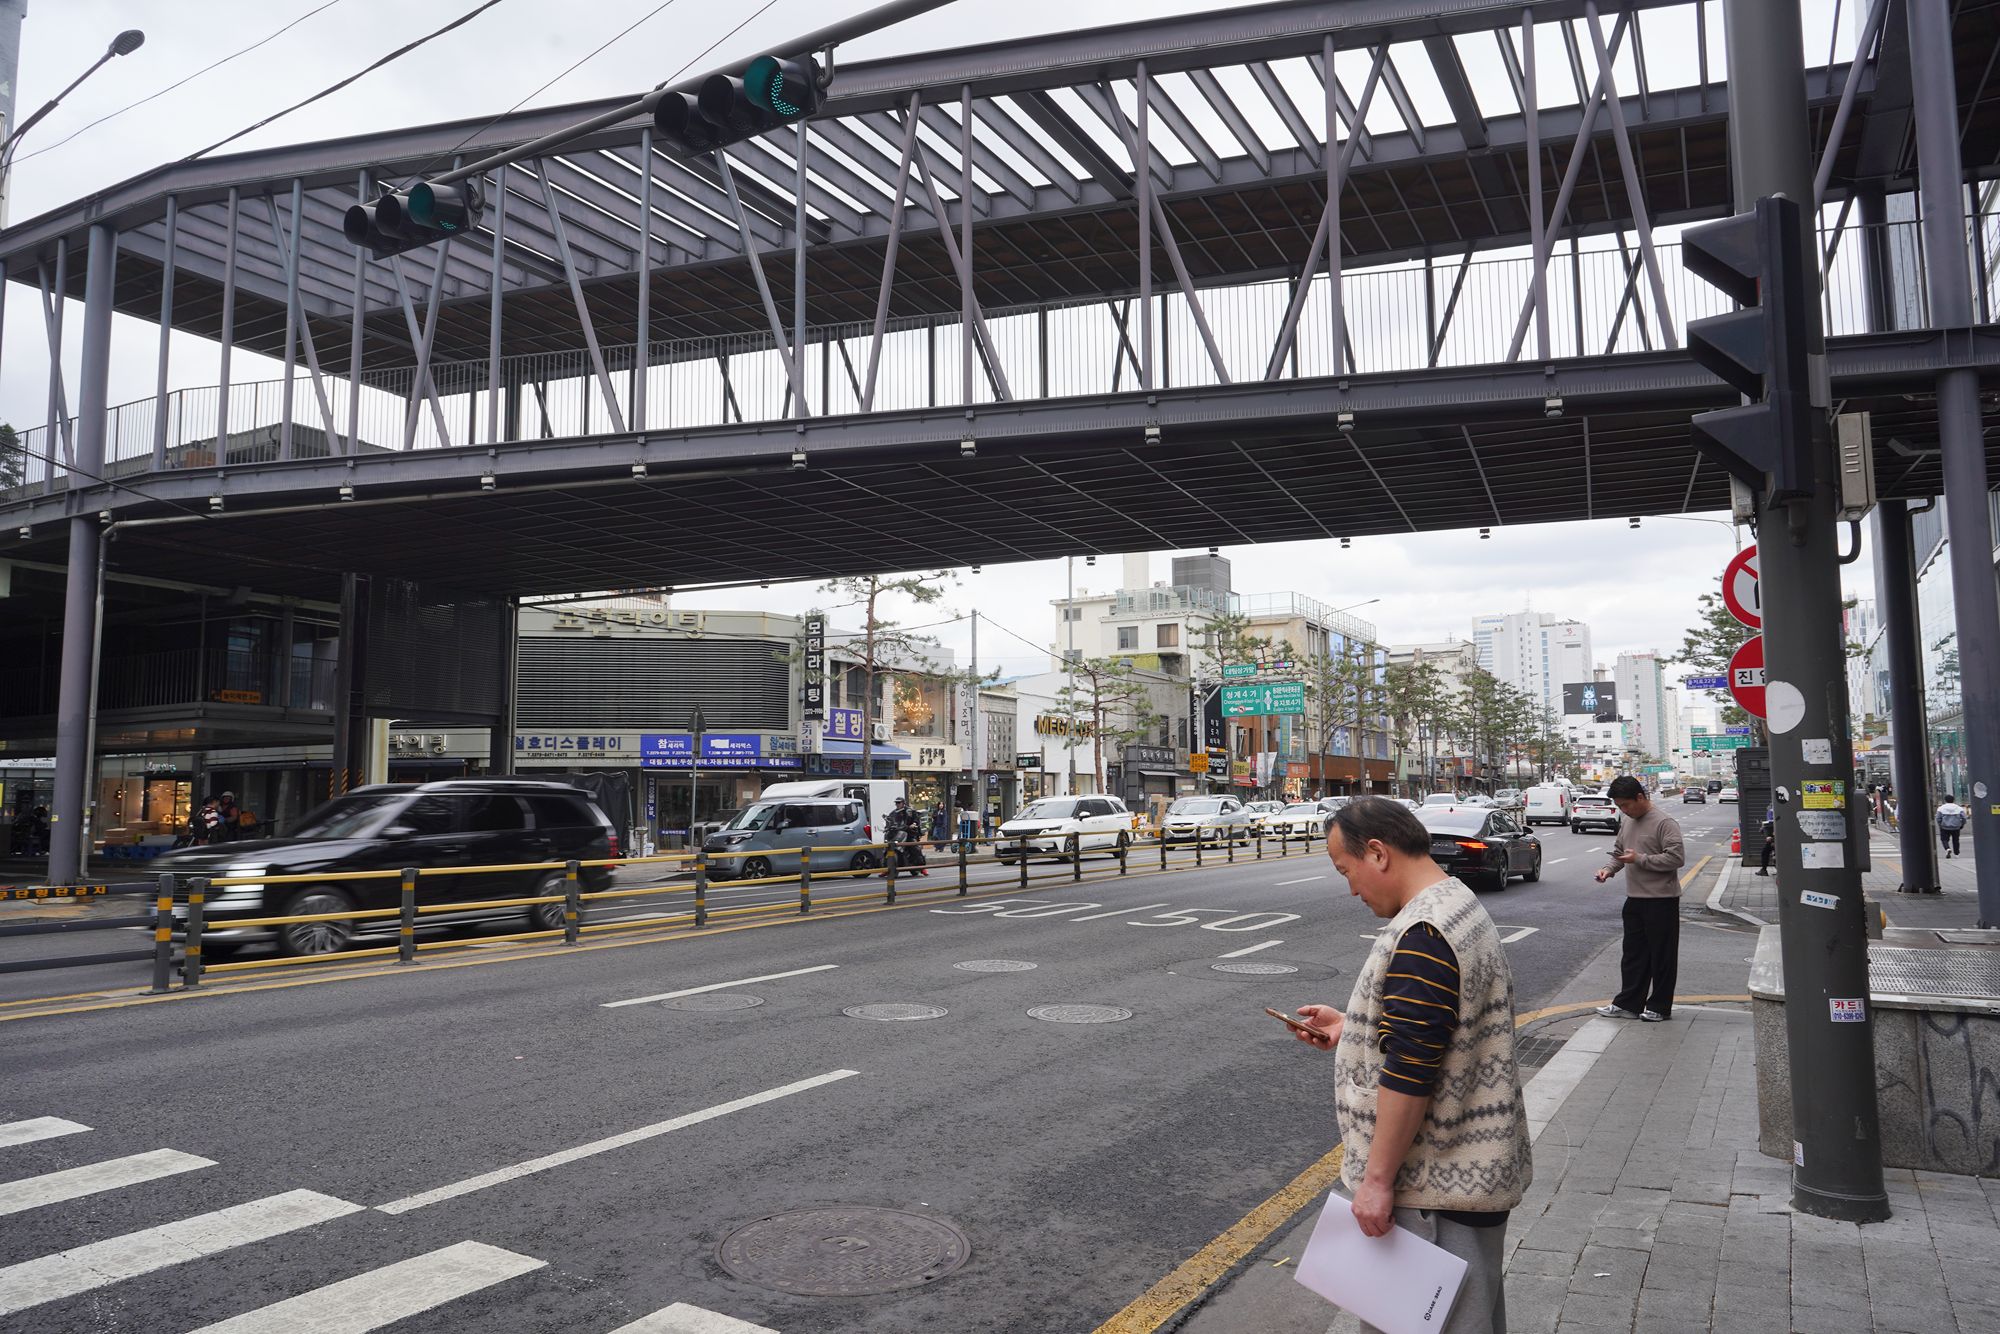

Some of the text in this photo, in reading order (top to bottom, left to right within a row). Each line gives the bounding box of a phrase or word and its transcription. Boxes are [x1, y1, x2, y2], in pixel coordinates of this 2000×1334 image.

[929, 899, 1103, 918] 50
[1126, 908, 1302, 932] 50
[1834, 1000, 1857, 1010] 카드
